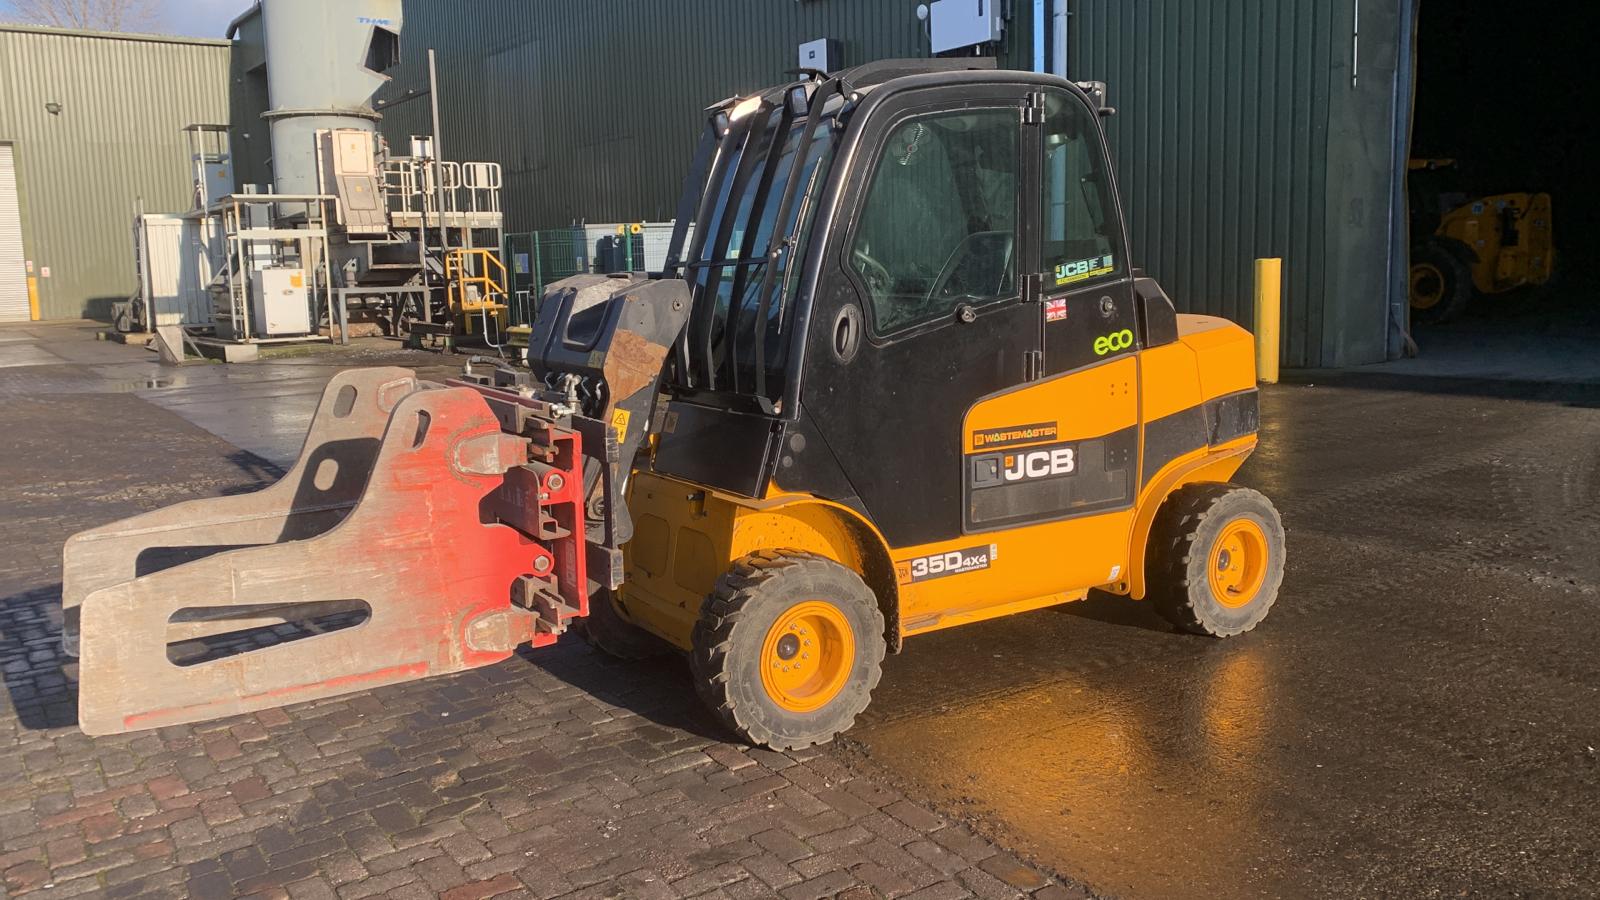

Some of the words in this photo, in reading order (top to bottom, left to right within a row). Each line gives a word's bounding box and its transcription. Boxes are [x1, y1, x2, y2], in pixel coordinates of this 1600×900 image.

[1056, 261, 1088, 278] JCB
[1094, 329, 1133, 355] eco
[984, 427, 1057, 443] WASTEMASTER
[1005, 448, 1075, 480] JCB
[912, 551, 963, 577] 35D
